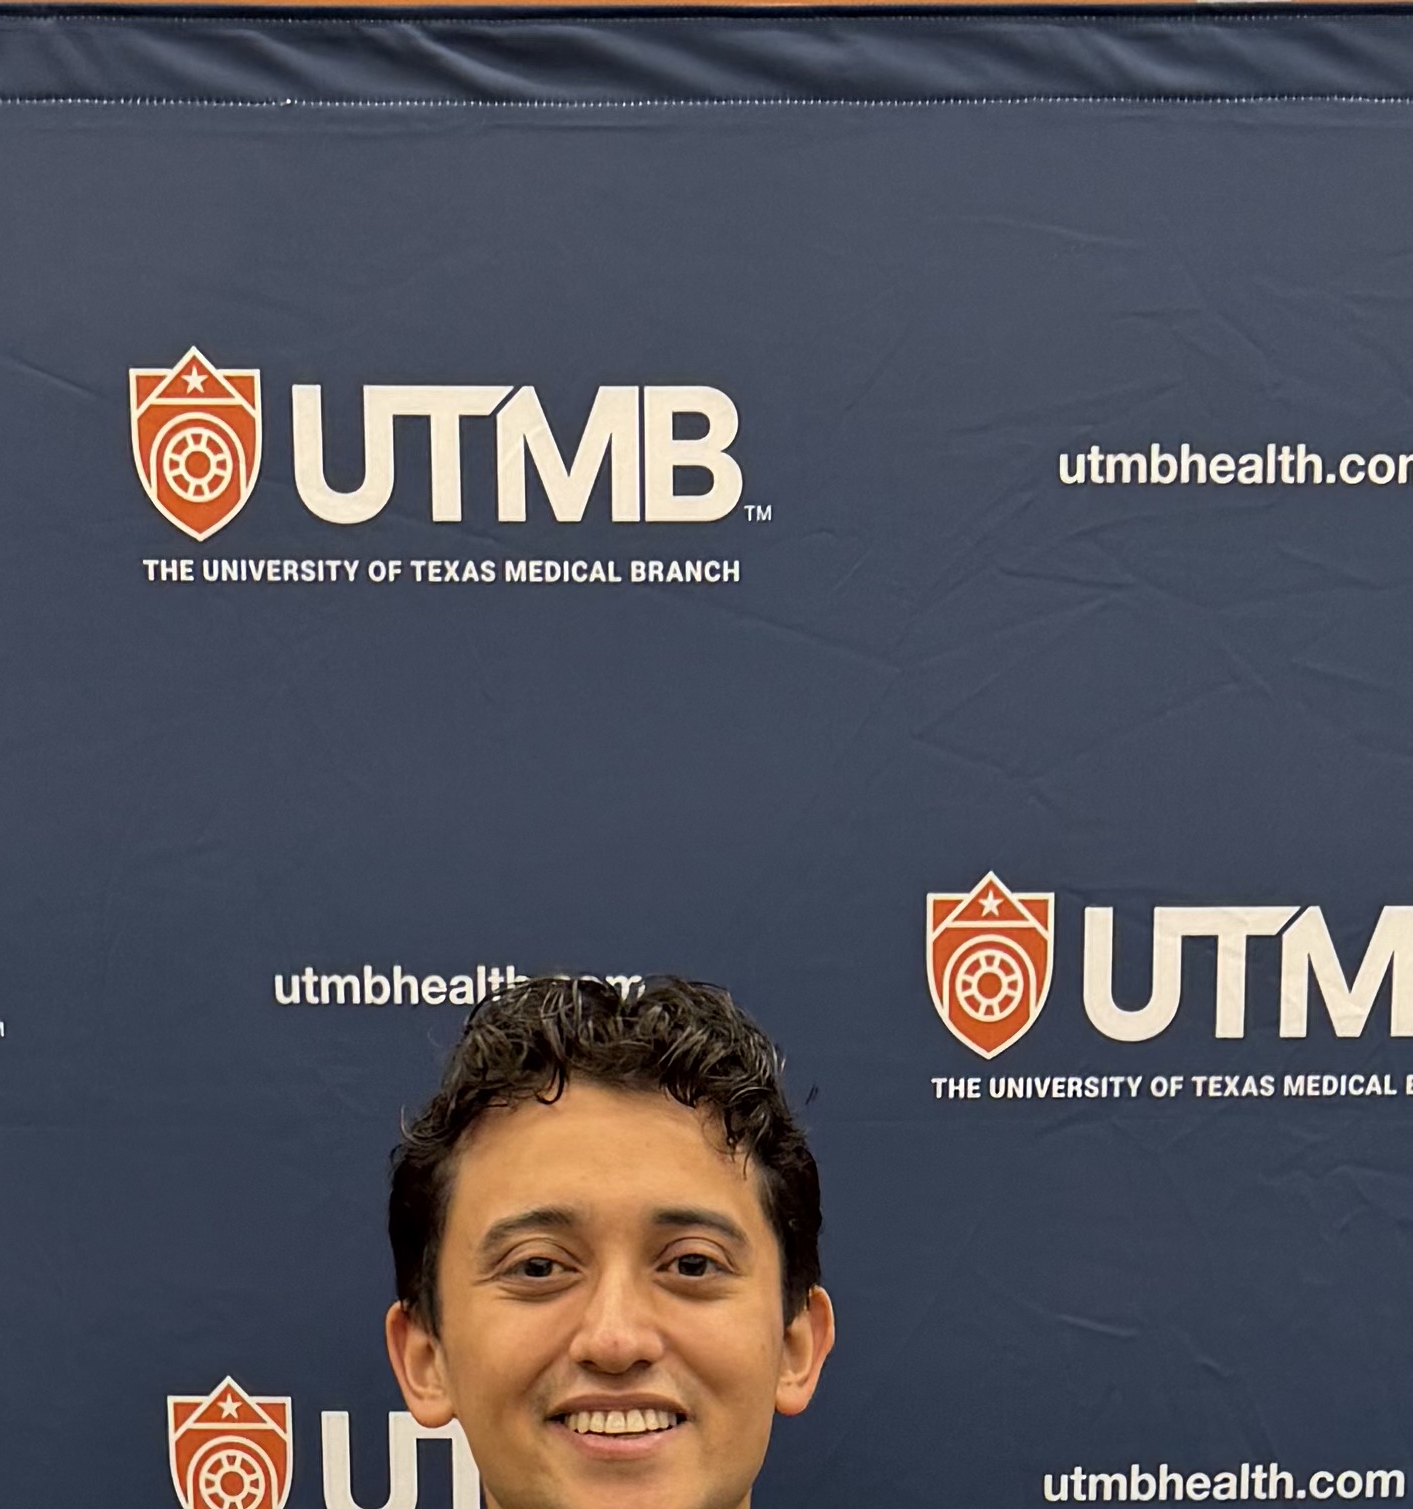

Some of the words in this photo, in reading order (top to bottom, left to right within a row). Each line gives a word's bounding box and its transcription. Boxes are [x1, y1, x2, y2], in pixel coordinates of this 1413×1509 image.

[292, 384, 743, 524] UTMB
[142, 559, 195, 582] THE
[202, 558, 360, 582] UNIVERSITY
[367, 559, 402, 583] OF
[409, 559, 496, 583] TEXAS
[504, 559, 623, 583] MEDICAL
[630, 559, 740, 583] BRANCH
[1043, 1462, 1405, 1502] utmbhealth.com
